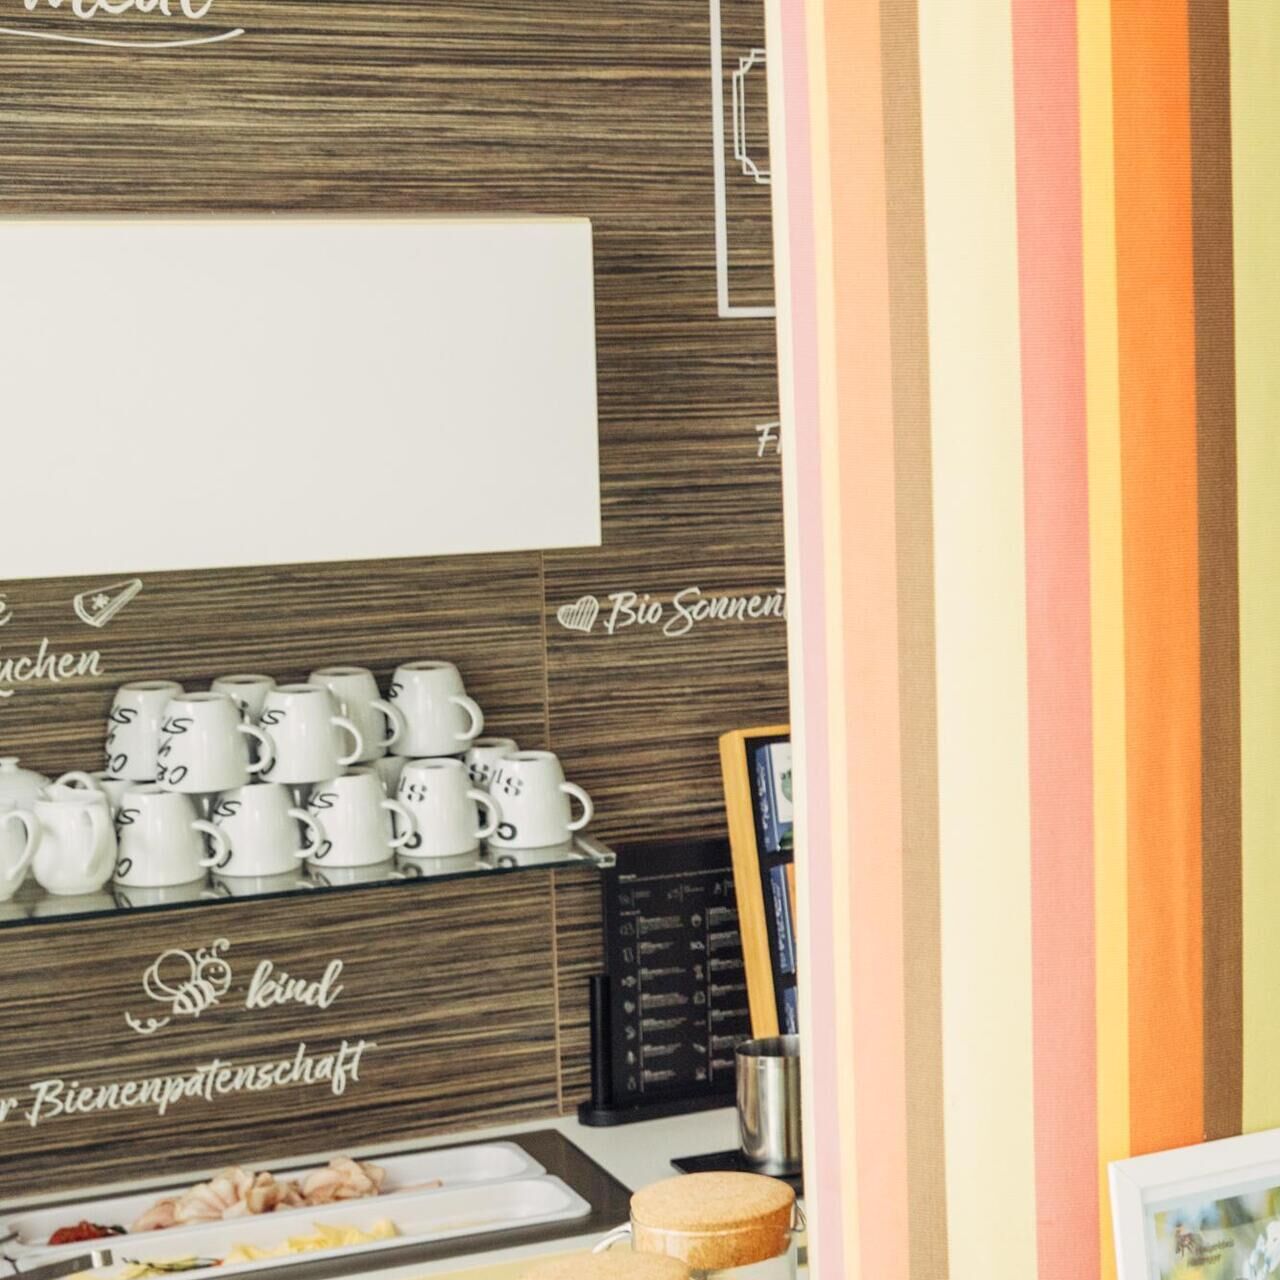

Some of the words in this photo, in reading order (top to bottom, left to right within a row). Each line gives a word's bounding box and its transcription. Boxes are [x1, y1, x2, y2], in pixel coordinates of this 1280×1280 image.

[603, 591, 663, 635] Bio
[245, 959, 344, 1009] kind
[25, 1039, 378, 1128] Bienenpatenschaft
